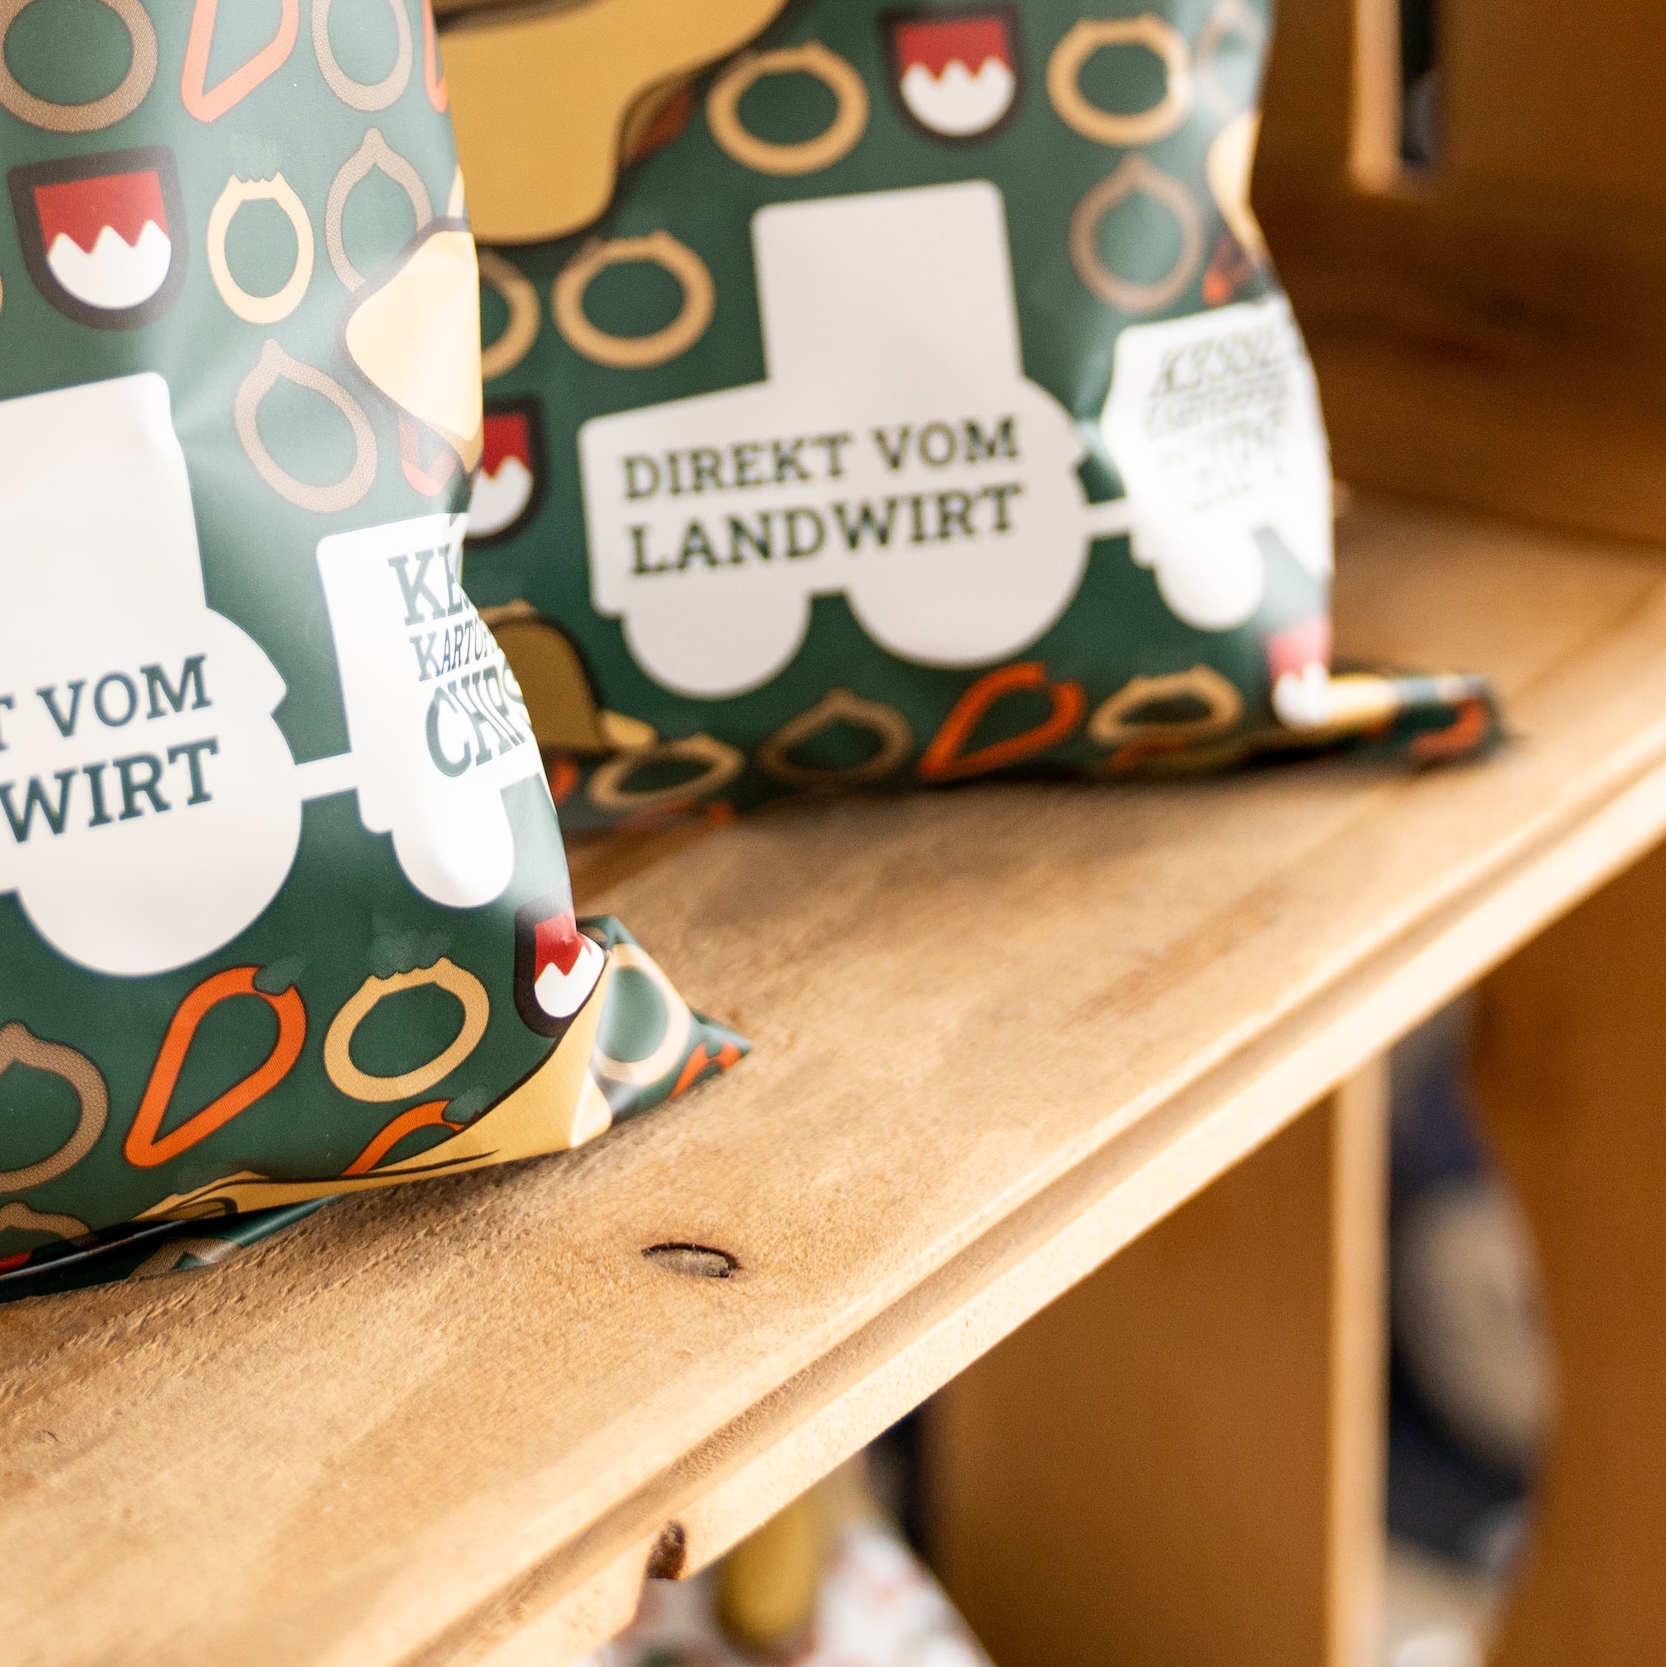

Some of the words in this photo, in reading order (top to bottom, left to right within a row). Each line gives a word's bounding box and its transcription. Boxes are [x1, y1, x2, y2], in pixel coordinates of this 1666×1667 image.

[621, 432, 852, 502] DIREKT
[871, 414, 1020, 472] VOM
[626, 481, 1024, 577] LANDWIRT
[35, 652, 214, 738] VOM
